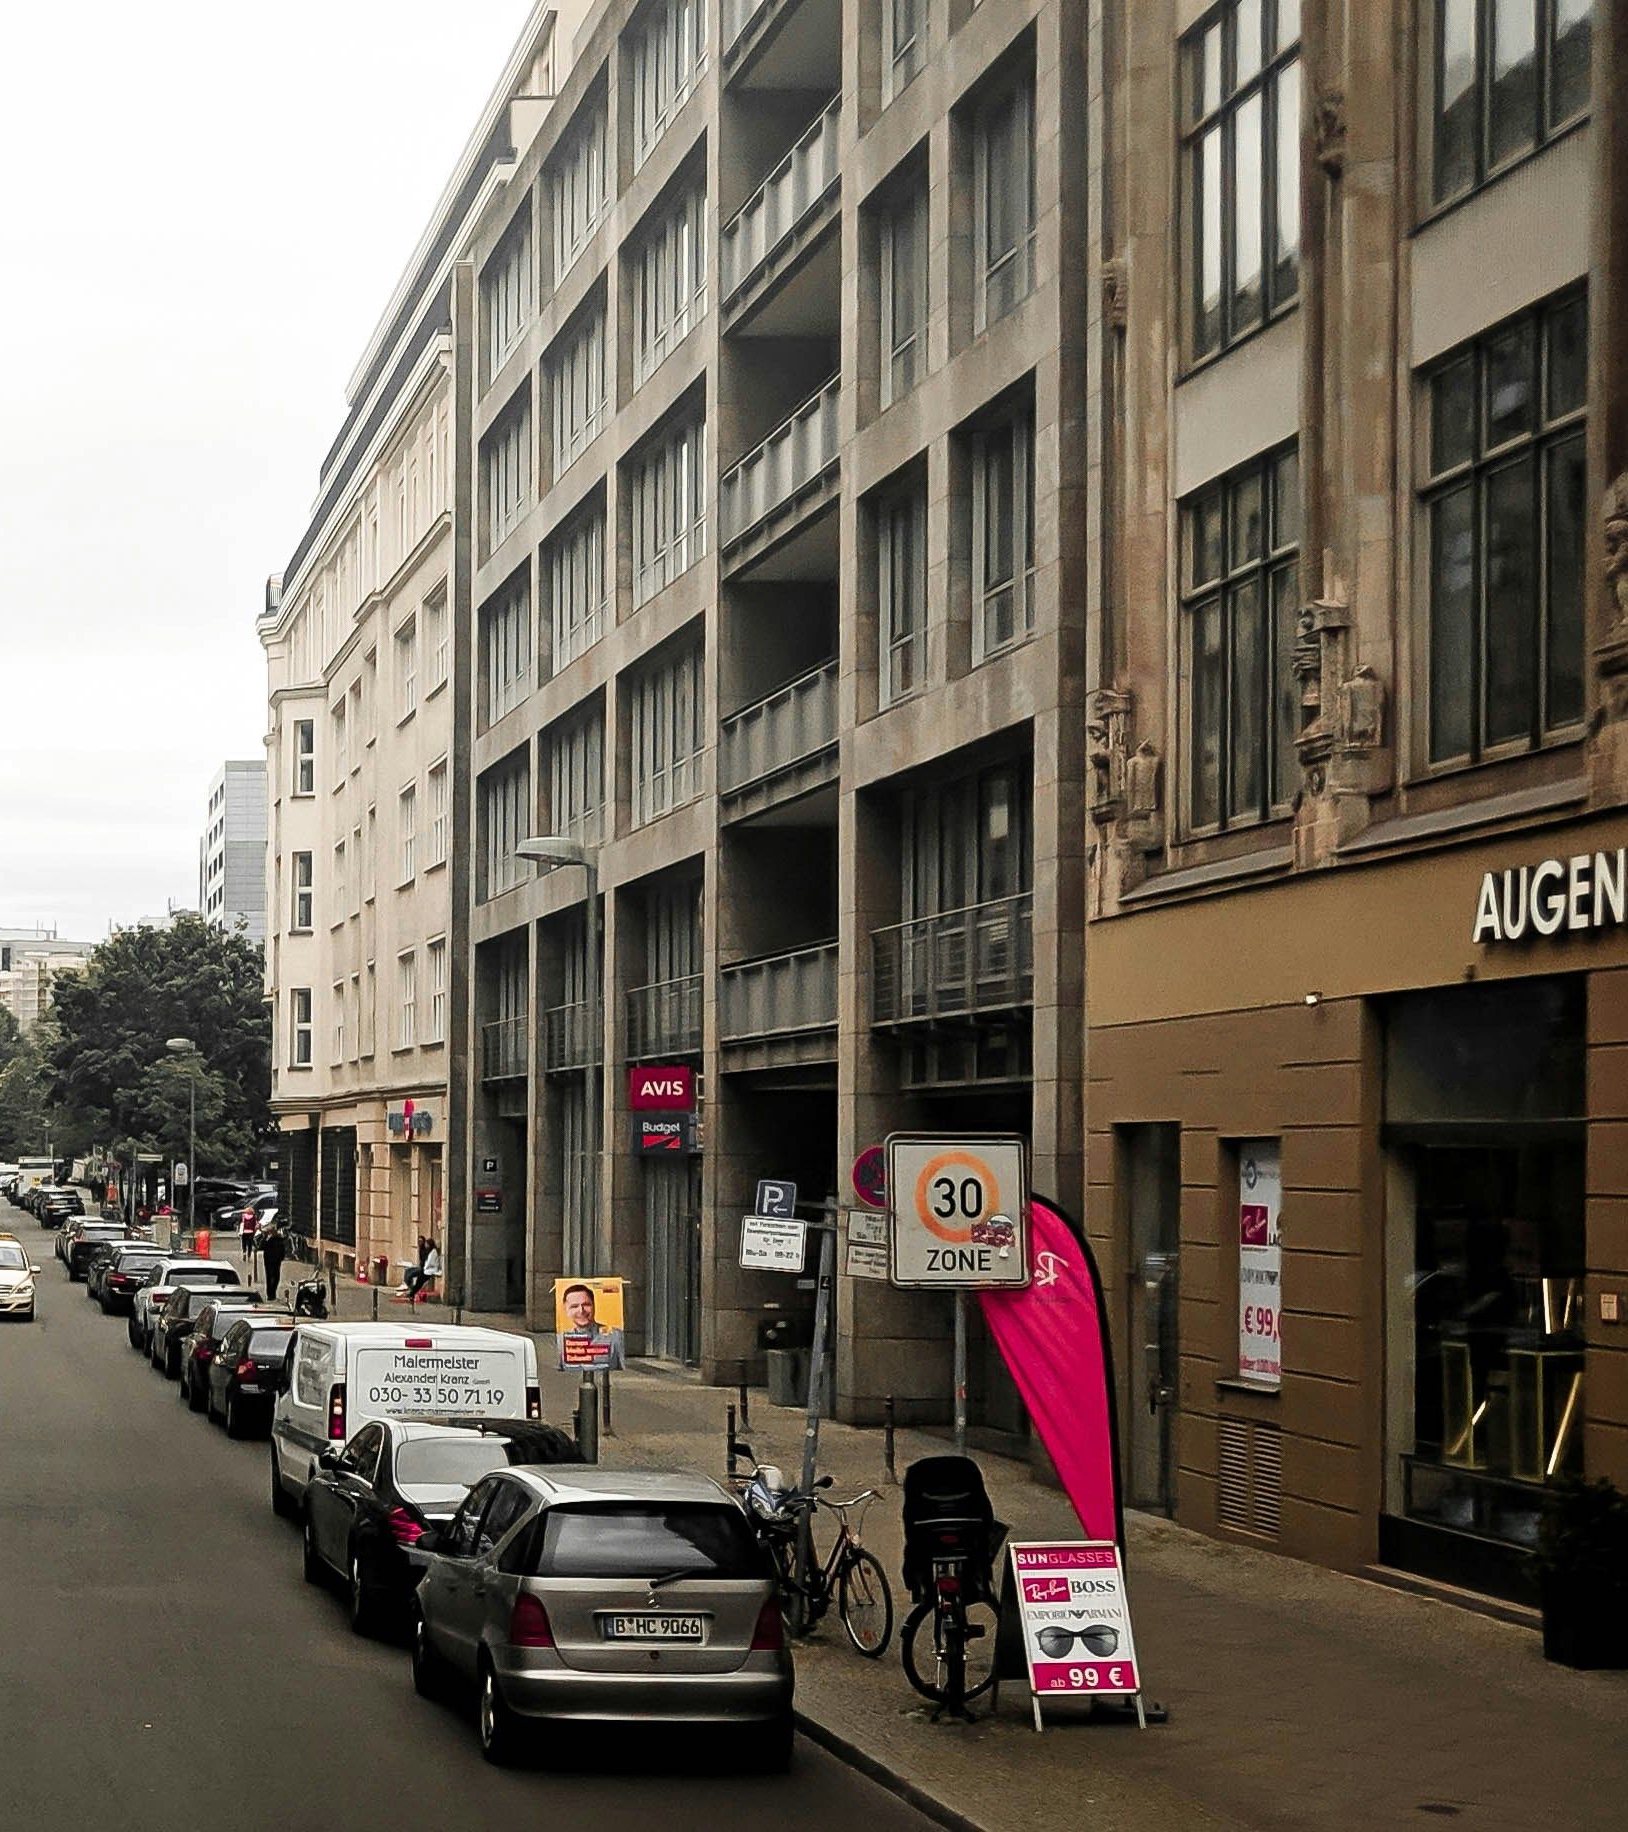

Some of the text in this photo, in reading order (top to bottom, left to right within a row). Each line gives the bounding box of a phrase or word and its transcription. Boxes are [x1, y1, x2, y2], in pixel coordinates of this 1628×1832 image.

[1472, 848, 1625, 943] AUGEN
[640, 1080, 684, 1097] AVIS
[642, 1121, 681, 1134] Budget
[762, 1185, 784, 1214] P
[933, 1177, 983, 1218] 30
[926, 1249, 992, 1272] ZONE
[394, 1355, 480, 1370] Malermeister
[384, 1373, 437, 1384] Alexander
[440, 1374, 470, 1385] Kranz
[413, 1387, 432, 1403] 33
[437, 1388, 459, 1404] 50
[1017, 1551, 1115, 1565] SUNGLASSES
[1070, 1580, 1116, 1594] BOSS
[660, 1618, 700, 1635] 9066
[1050, 1667, 1124, 1688] ab 99 €
